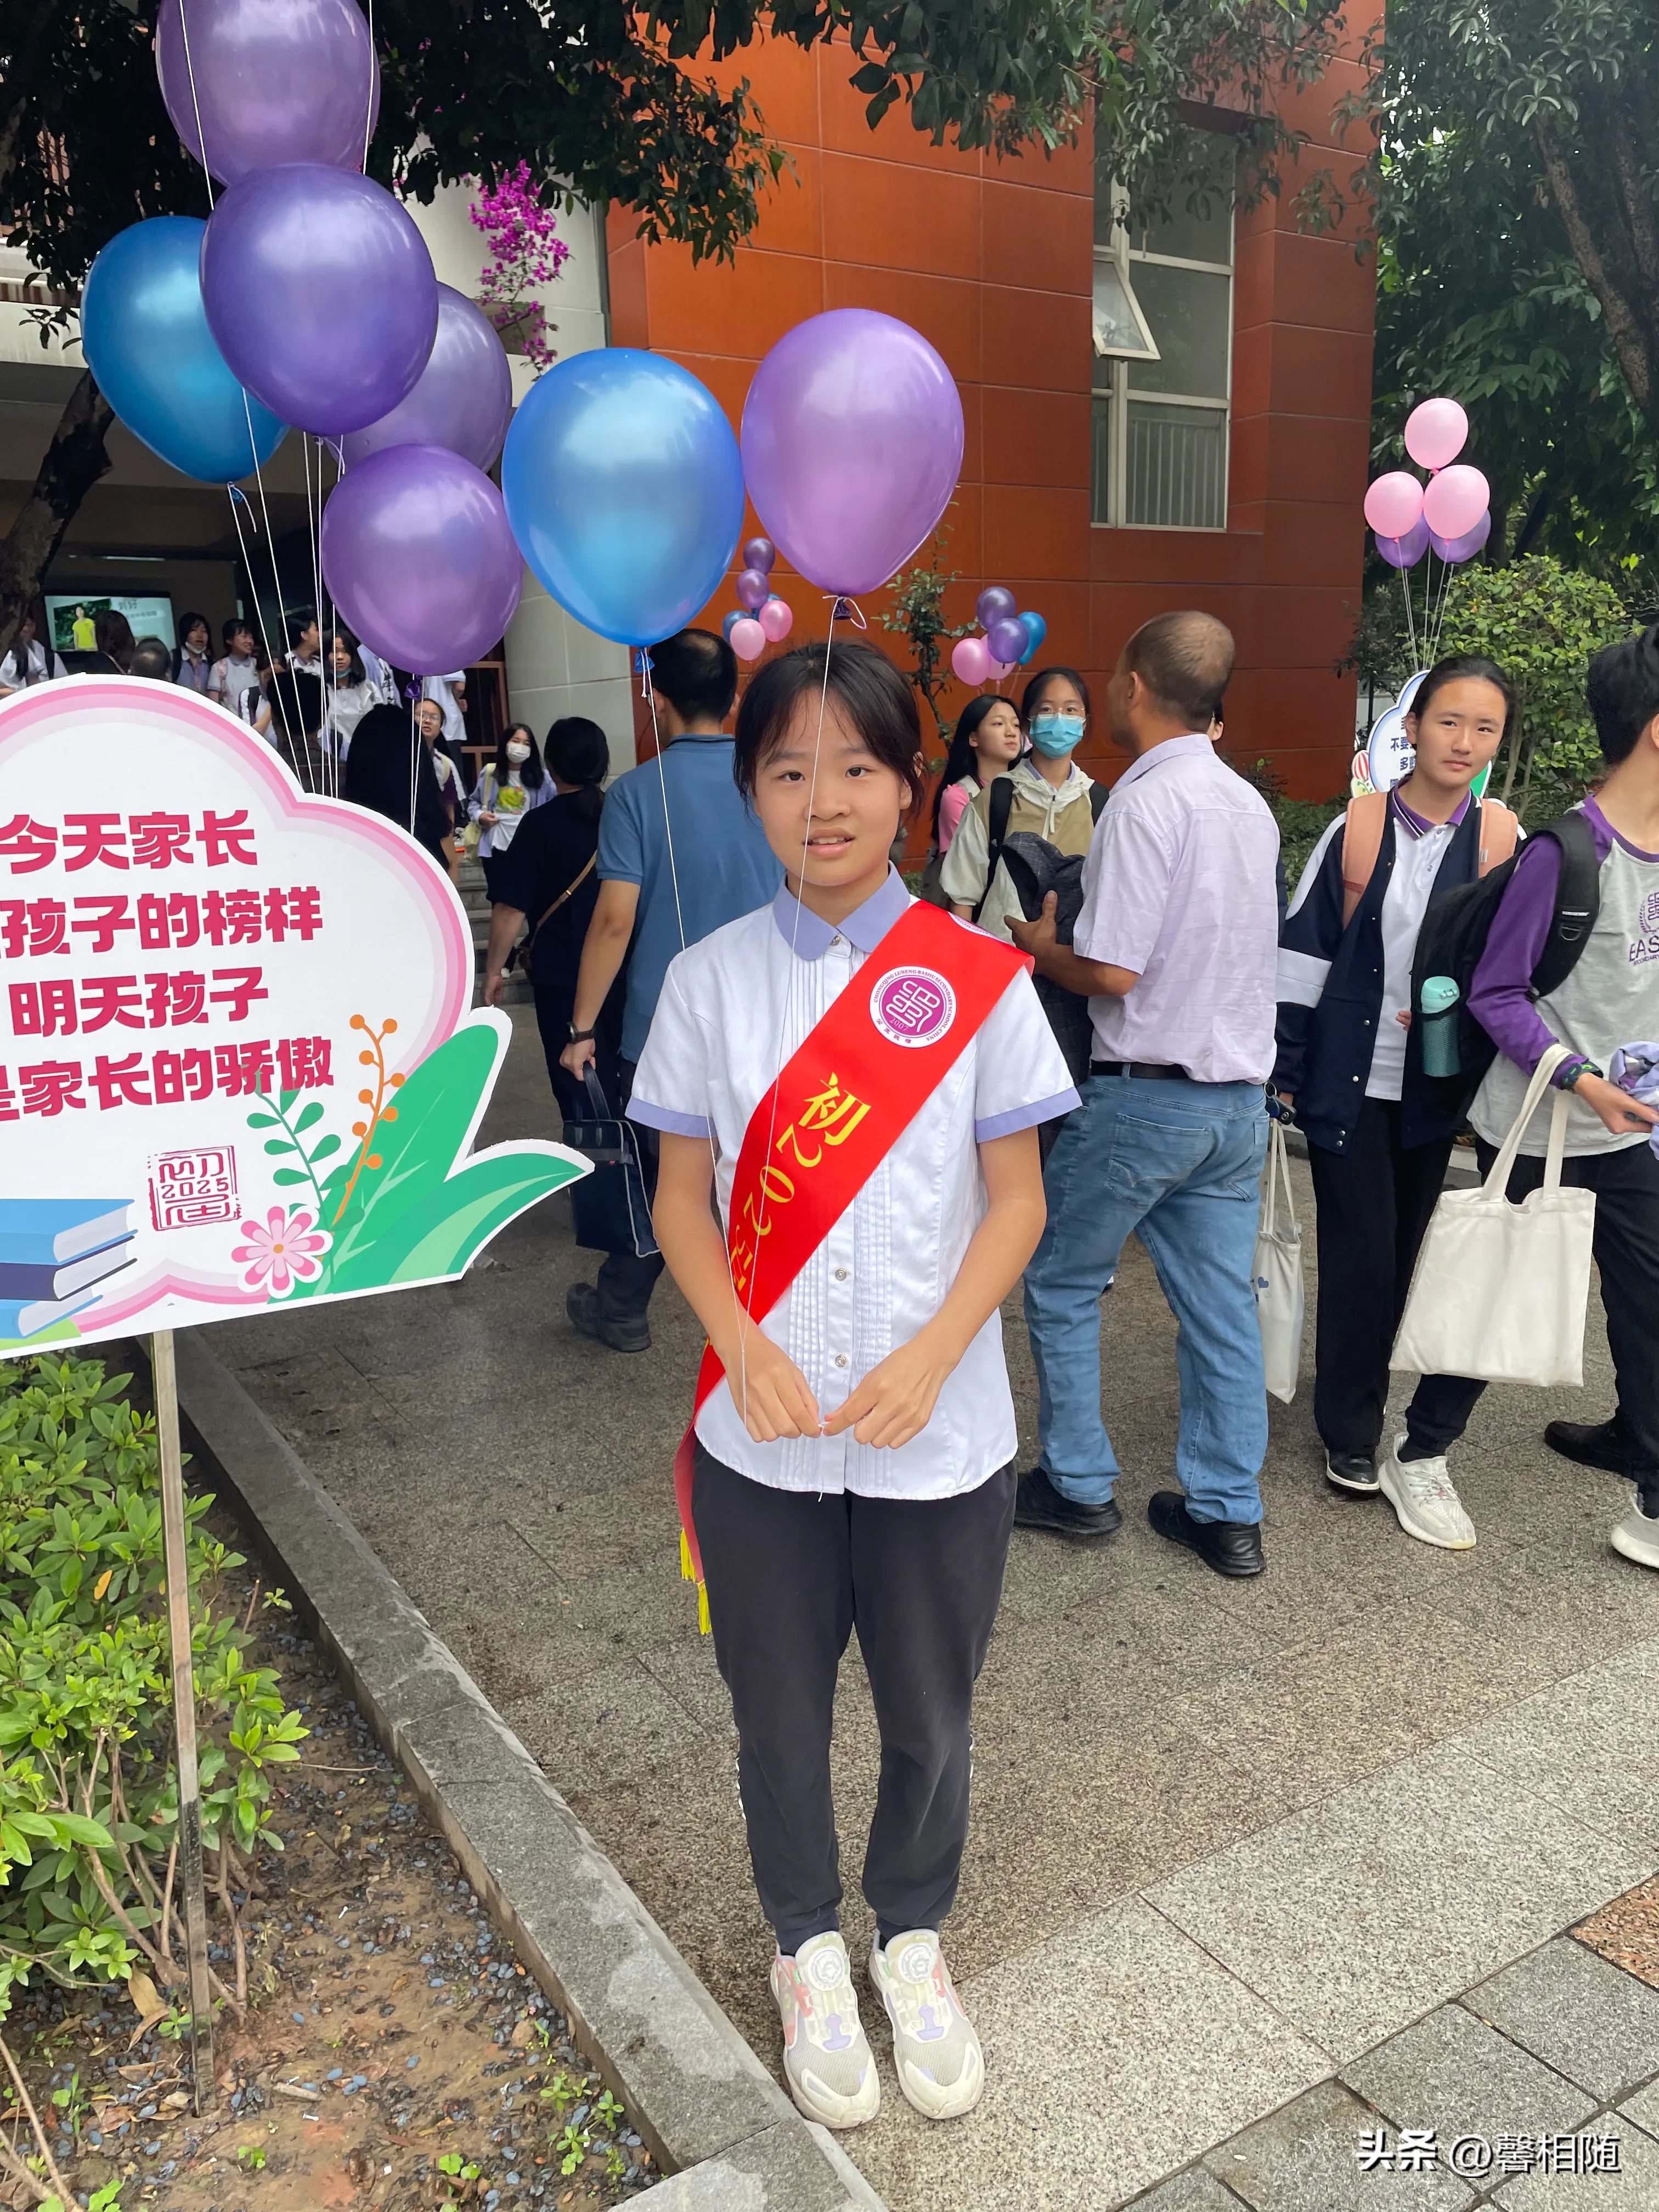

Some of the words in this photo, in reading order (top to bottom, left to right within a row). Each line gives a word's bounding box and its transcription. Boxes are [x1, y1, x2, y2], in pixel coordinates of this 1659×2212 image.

[1390, 736, 1414, 752] 不要
[0, 810, 258, 874] 今天家长
[8, 967, 268, 1037] 明天孩子
[873, 974, 895, 1003] CHONGQING
[917, 970, 936, 979] BASHU
[935, 977, 953, 1006] SECONDARY
[889, 1017, 909, 1031] 2007
[161, 1177, 229, 1199] 2025
